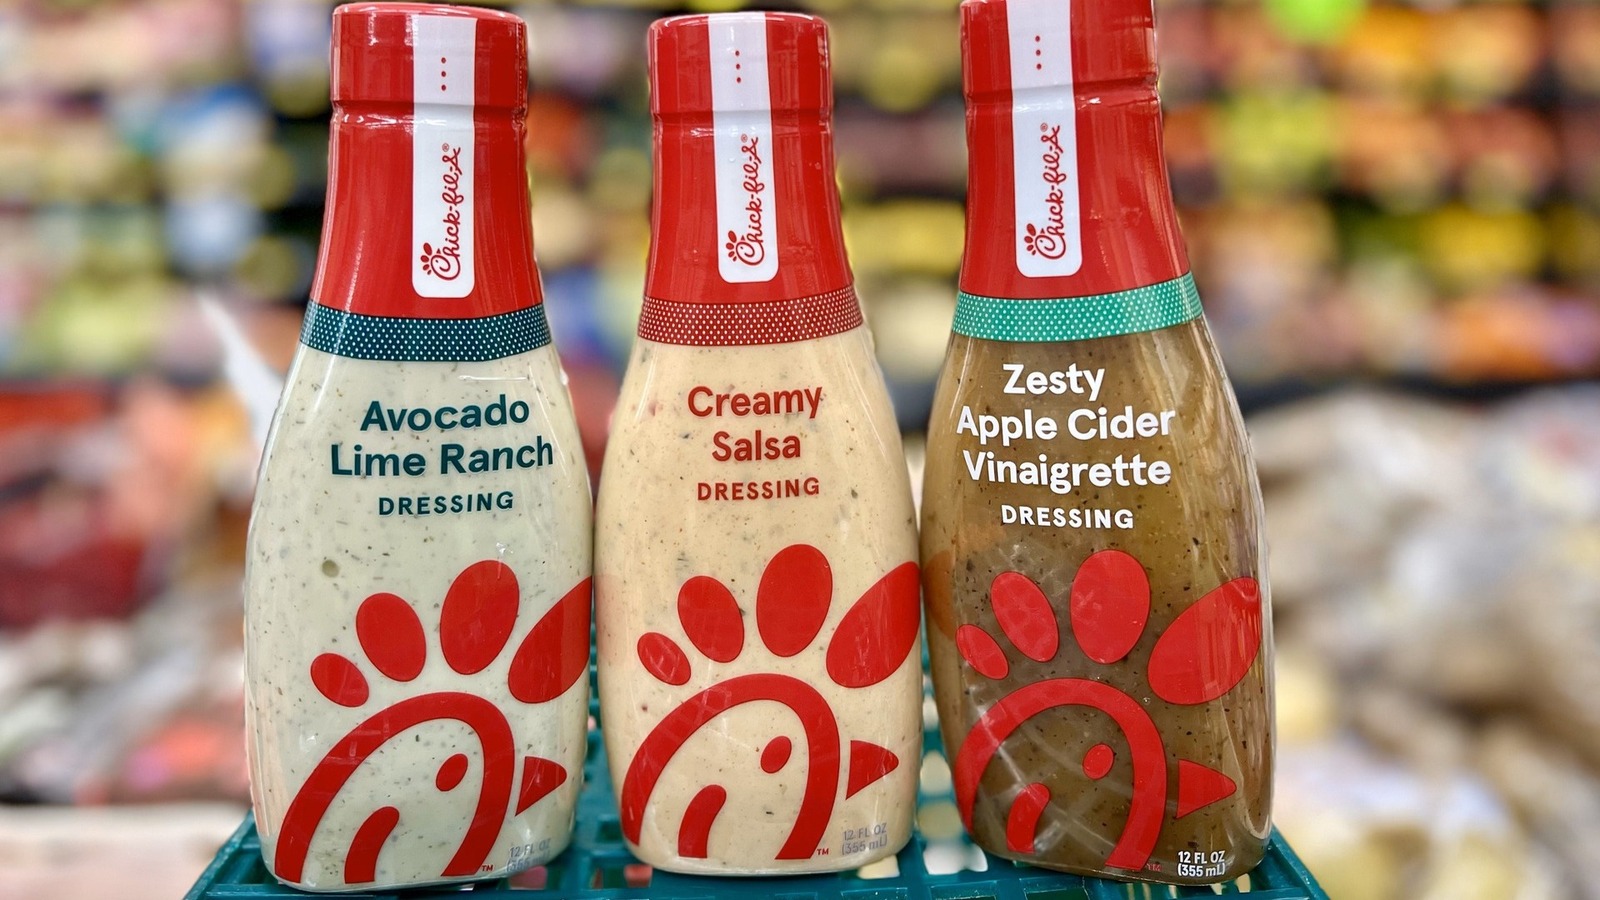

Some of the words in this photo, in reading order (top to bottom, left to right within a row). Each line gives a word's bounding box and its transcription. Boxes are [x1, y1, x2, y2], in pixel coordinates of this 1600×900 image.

[1003, 363, 1105, 401] Zesty
[360, 394, 529, 431] Avocado
[688, 386, 822, 419] Creamy
[956, 405, 1057, 446] Apple
[1068, 406, 1176, 440] Cider
[331, 444, 426, 476] Lime
[440, 435, 553, 474] Ranch
[712, 430, 801, 461] Salsa
[963, 450, 1171, 494] Vinaigrette
[379, 491, 513, 515] DRESSING
[697, 477, 819, 501] DRESSING
[1002, 505, 1134, 529] DRESSING
[844, 830, 854, 840] 12
[858, 828, 870, 838] FL
[874, 823, 887, 835] OZ
[1178, 851, 1191, 863] 12
[1194, 852, 1207, 864] FL
[1210, 850, 1225, 862] OZ
[1178, 863, 1203, 877] (355
[1205, 863, 1226, 877] mL)
